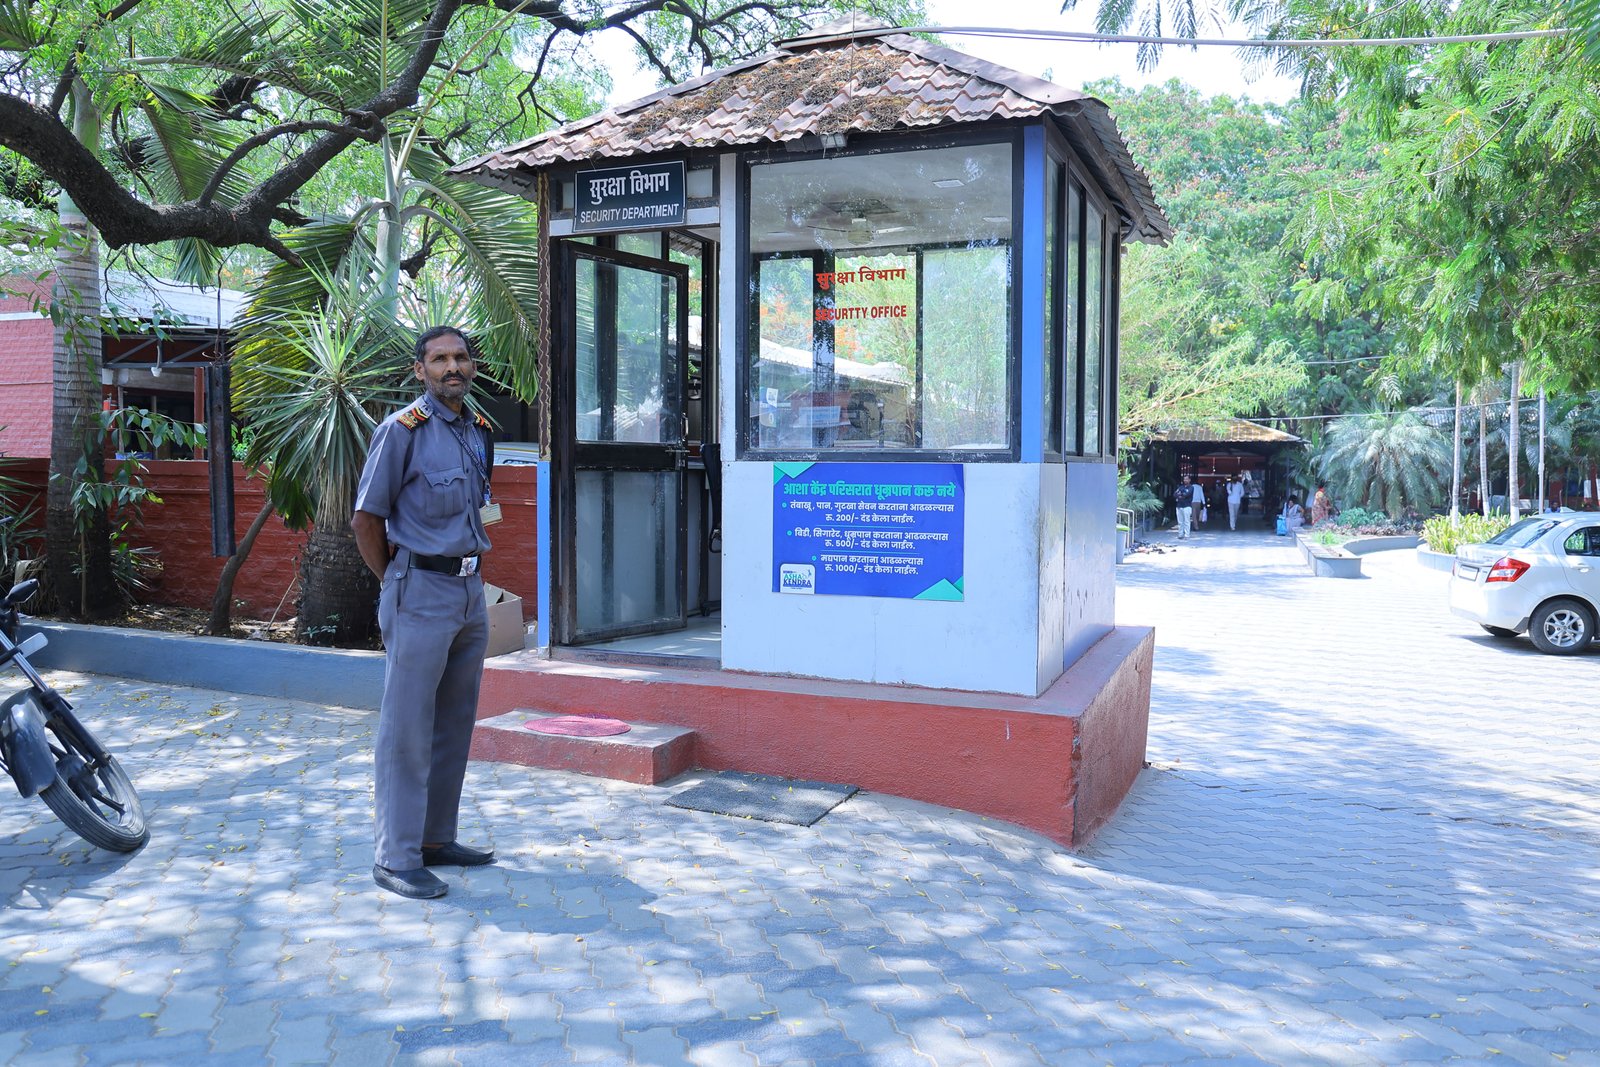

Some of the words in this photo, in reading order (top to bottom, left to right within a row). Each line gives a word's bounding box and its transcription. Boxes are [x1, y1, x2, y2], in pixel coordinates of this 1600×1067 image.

[590, 177, 626, 205] सुरक्षा
[630, 170, 670, 194] विभाग
[580, 208, 621, 224] SECURITY
[622, 204, 680, 220] DEPARTMENT
[816, 272, 855, 291] सुरक्षा
[858, 266, 906, 282] विभाग
[870, 305, 907, 319] OFFICE
[784, 483, 808, 495] आशा
[810, 480, 827, 496] केंद्र
[828, 480, 872, 496] परिसरात
[874, 484, 912, 500] धूम्रपान
[936, 482, 956, 497] नये
[834, 502, 856, 512] गुटखा
[858, 501, 876, 510] सेवन
[878, 502, 908, 511] करताना
[910, 504, 954, 512] आढळल्यास
[836, 513, 859, 523] 200/-
[860, 513, 870, 522] दंड
[872, 513, 890, 522] केला
[891, 514, 916, 523] जाईल.
[872, 532, 903, 540] करताना
[904, 532, 948, 540] आढळल्यास
[836, 538, 858, 548] 500/-
[860, 539, 870, 548] दंड
[872, 539, 890, 548] केला
[891, 540, 916, 550] जाईल.
[849, 556, 878, 564] करताना
[880, 556, 924, 565] आढळल्यास
[836, 564, 862, 574] 1000/-
[864, 564, 874, 573] दंड
[875, 564, 892, 574] केला
[894, 564, 918, 574] जाईल.
